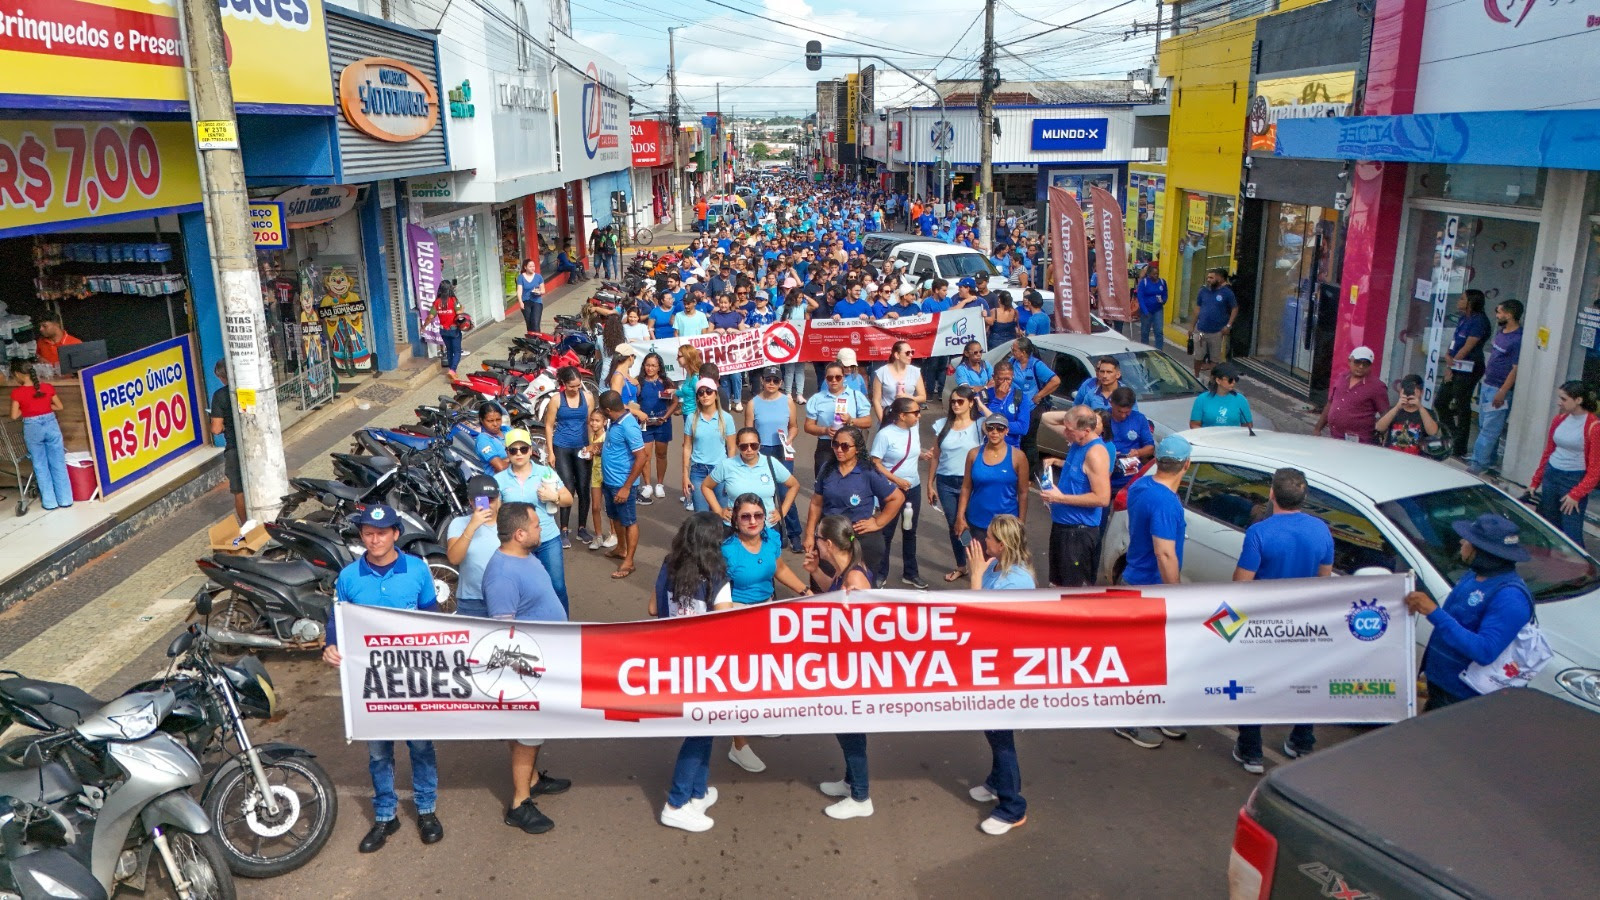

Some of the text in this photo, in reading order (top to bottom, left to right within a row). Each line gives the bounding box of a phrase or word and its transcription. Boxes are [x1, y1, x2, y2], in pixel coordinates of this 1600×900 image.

[114, 33, 125, 48] e
[130, 30, 186, 57] Presen
[630, 125, 643, 135] RA
[54, 127, 161, 210] 7,00
[411, 188, 451, 197] sorriso
[253, 232, 279, 242] 7,00
[416, 241, 436, 311] DENTISTA
[1059, 213, 1073, 319] mahogany
[226, 316, 251, 324] ARTAS
[1423, 217, 1458, 402] COMUNICAD
[688, 336, 718, 348] TODOS
[755, 329, 760, 338] A
[100, 362, 183, 411] PREÇO ÚNICO
[108, 393, 188, 462] R$ 7,00
[769, 606, 972, 646] DENGUE,
[1244, 622, 1329, 638] ARAGUAÍNA
[1355, 617, 1380, 630] CCZ
[366, 631, 469, 646] ARAGUAÍNA
[369, 649, 465, 668] CONTRA O
[363, 665, 473, 700] AEDES
[618, 646, 1129, 696] CHIKUNGUNYA E ZIKA
[1204, 687, 1221, 695] SUS
[1329, 682, 1396, 696] BRASIL
[369, 703, 418, 712] DENGUE,
[420, 703, 499, 711] CHIKUNGUNYA
[511, 702, 537, 711] ZIKA
[691, 690, 1166, 724] O perigo aumentou. E a responsabilidade de todos também.
[1298, 862, 1380, 900] 4X
